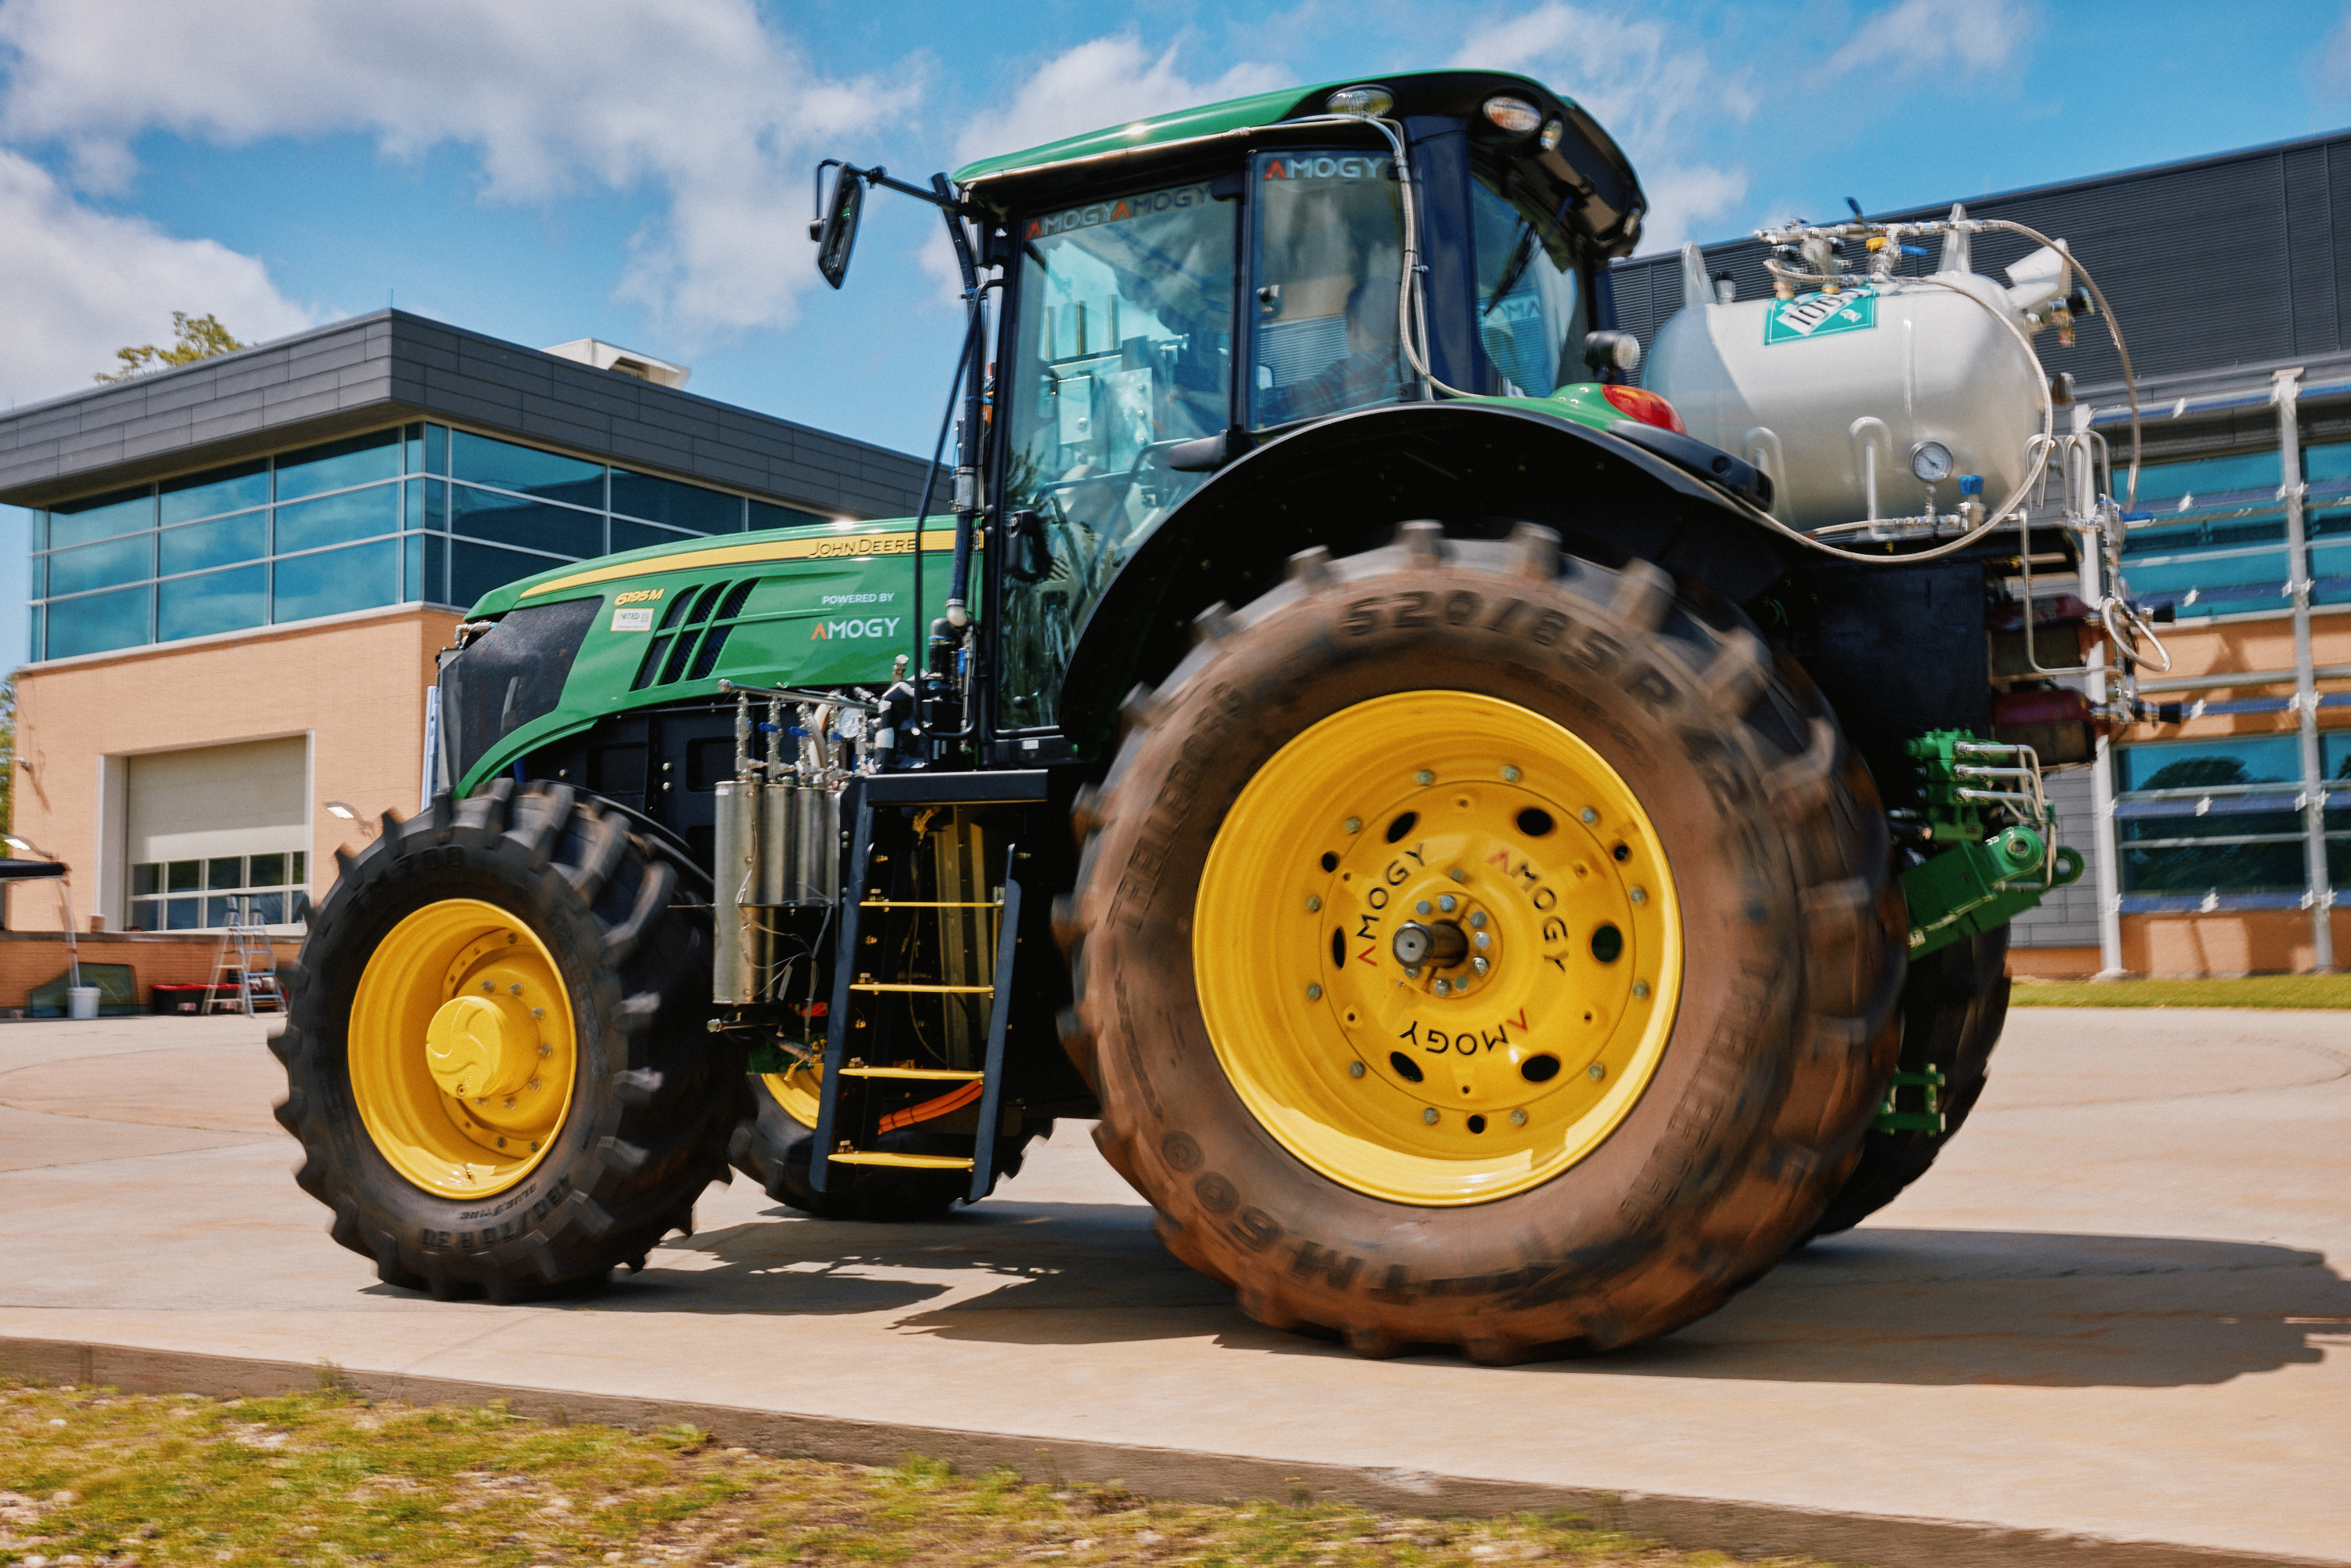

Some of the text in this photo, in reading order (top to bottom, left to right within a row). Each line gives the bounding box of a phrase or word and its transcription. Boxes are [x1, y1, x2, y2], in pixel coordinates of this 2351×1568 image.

[1262, 158, 1384, 180] AMOGY
[1023, 201, 1119, 240] AMOGY
[807, 538, 916, 558] JOHN DEERE
[614, 588, 665, 607] 6195M
[821, 592, 895, 605] POWERED BY
[810, 617, 900, 640] AMOGY
[1357, 842, 1425, 967] AMOGY
[1486, 849, 1570, 973] AMOGY
[1400, 1007, 1528, 1056] AMOGY
